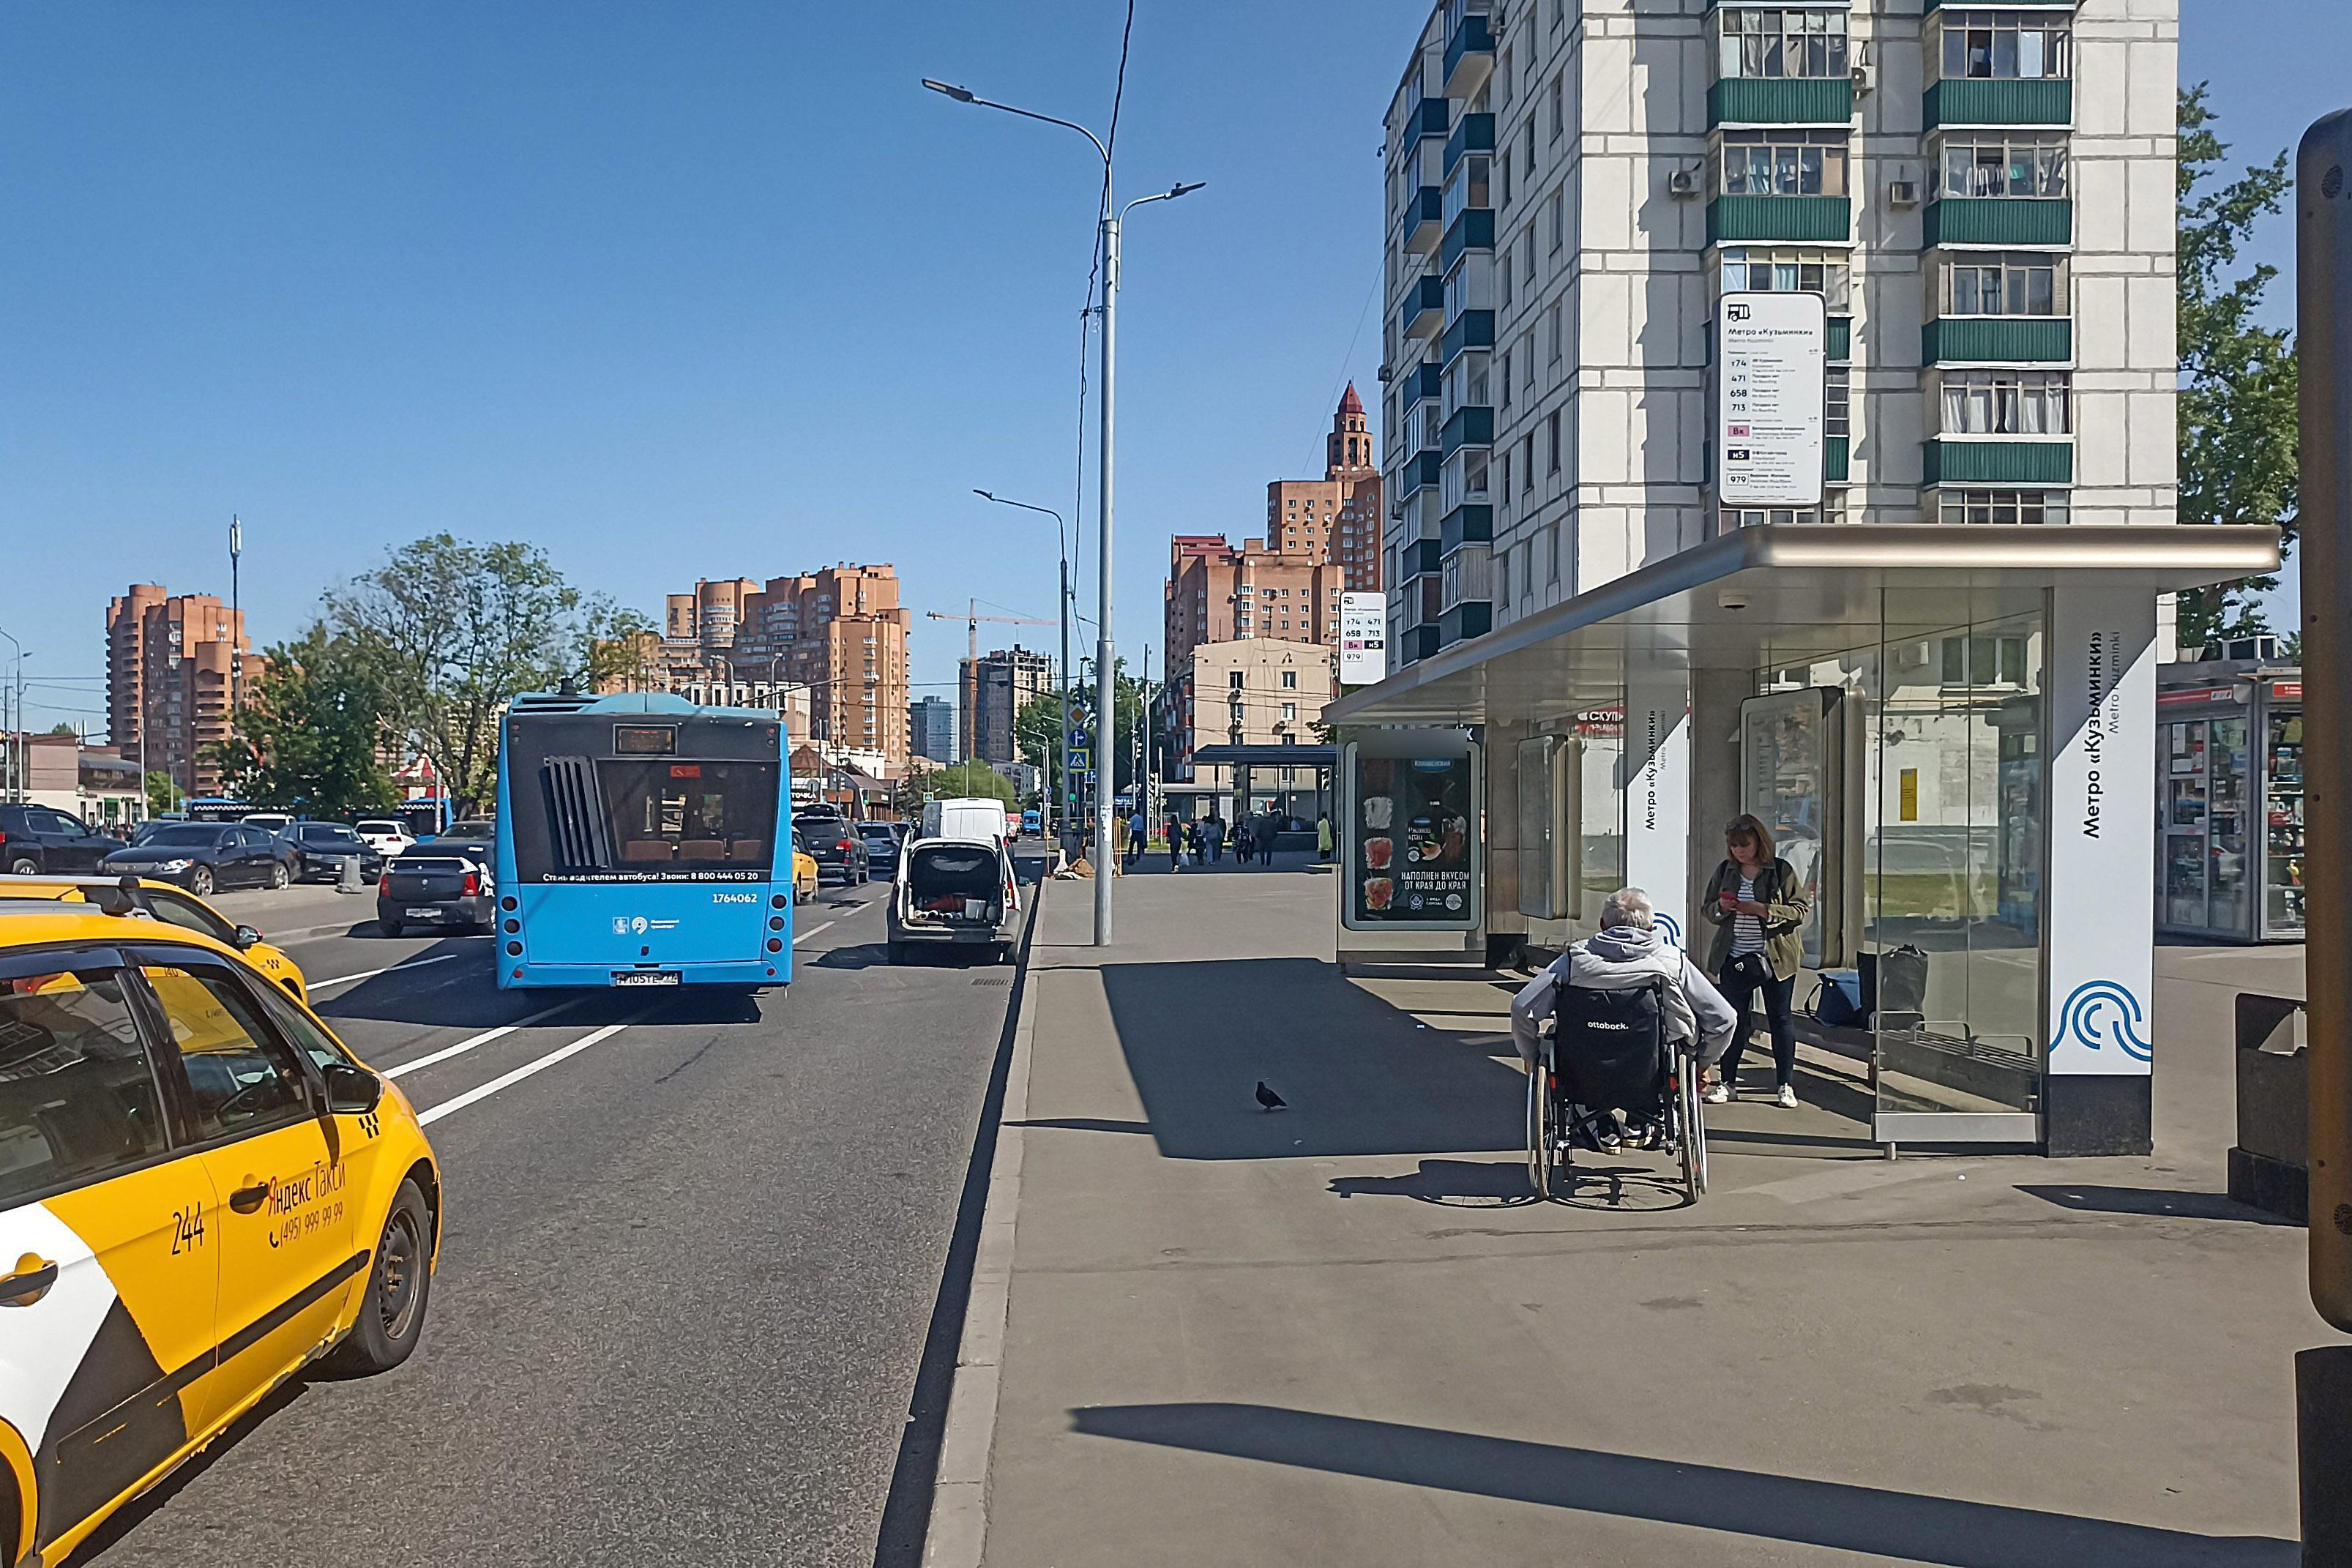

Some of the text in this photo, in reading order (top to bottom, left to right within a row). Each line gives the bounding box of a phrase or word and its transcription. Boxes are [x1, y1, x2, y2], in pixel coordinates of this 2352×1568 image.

[1730, 389, 1747, 397] 658
[2109, 695, 2119, 733] Metro
[2083, 632, 2105, 839] Метро «Кузьминки»
[1646, 711, 1657, 830] Метро «Кузьминки»
[619, 873, 660, 881] автобуса!
[690, 872, 697, 880] 8
[698, 872, 715, 880] 800
[717, 872, 733, 880] 444
[734, 872, 746, 880] 05
[747, 872, 758, 880] 20
[1401, 871, 1470, 881] НАПОЛНЕН ВКУСОМ
[1405, 881, 1466, 891] ОТ КРАЯ ДО КРАЯ
[713, 893, 758, 903] 1764062
[1588, 1022, 1629, 1030] ottobock.
[268, 1160, 346, 1217] Яндекс Такси
[171, 1201, 204, 1255] 244
[280, 1201, 343, 1247] (495) 999 99 99
